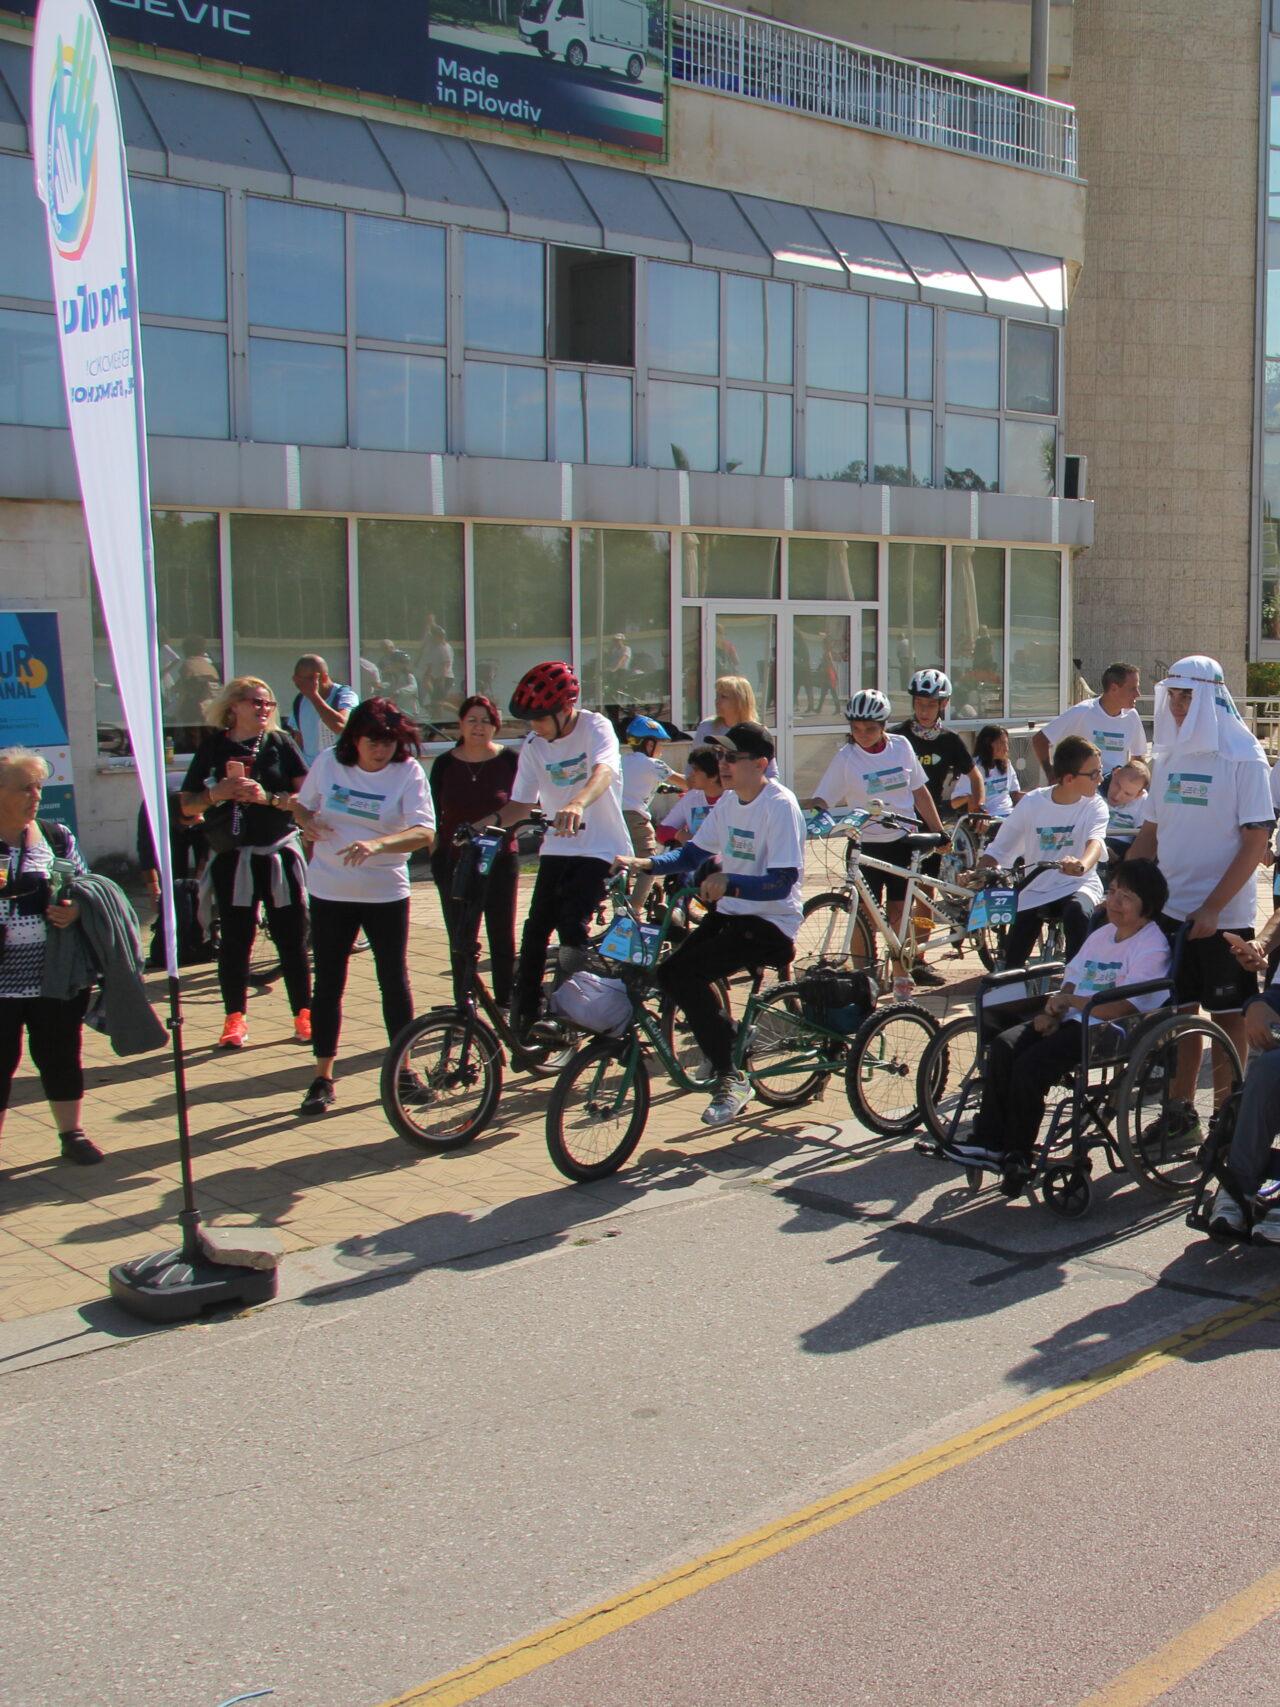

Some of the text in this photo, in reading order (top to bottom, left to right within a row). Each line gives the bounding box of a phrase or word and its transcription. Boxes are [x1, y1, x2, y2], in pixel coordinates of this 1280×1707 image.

[438, 57, 499, 89] Made
[437, 81, 542, 122] in Plovdiv
